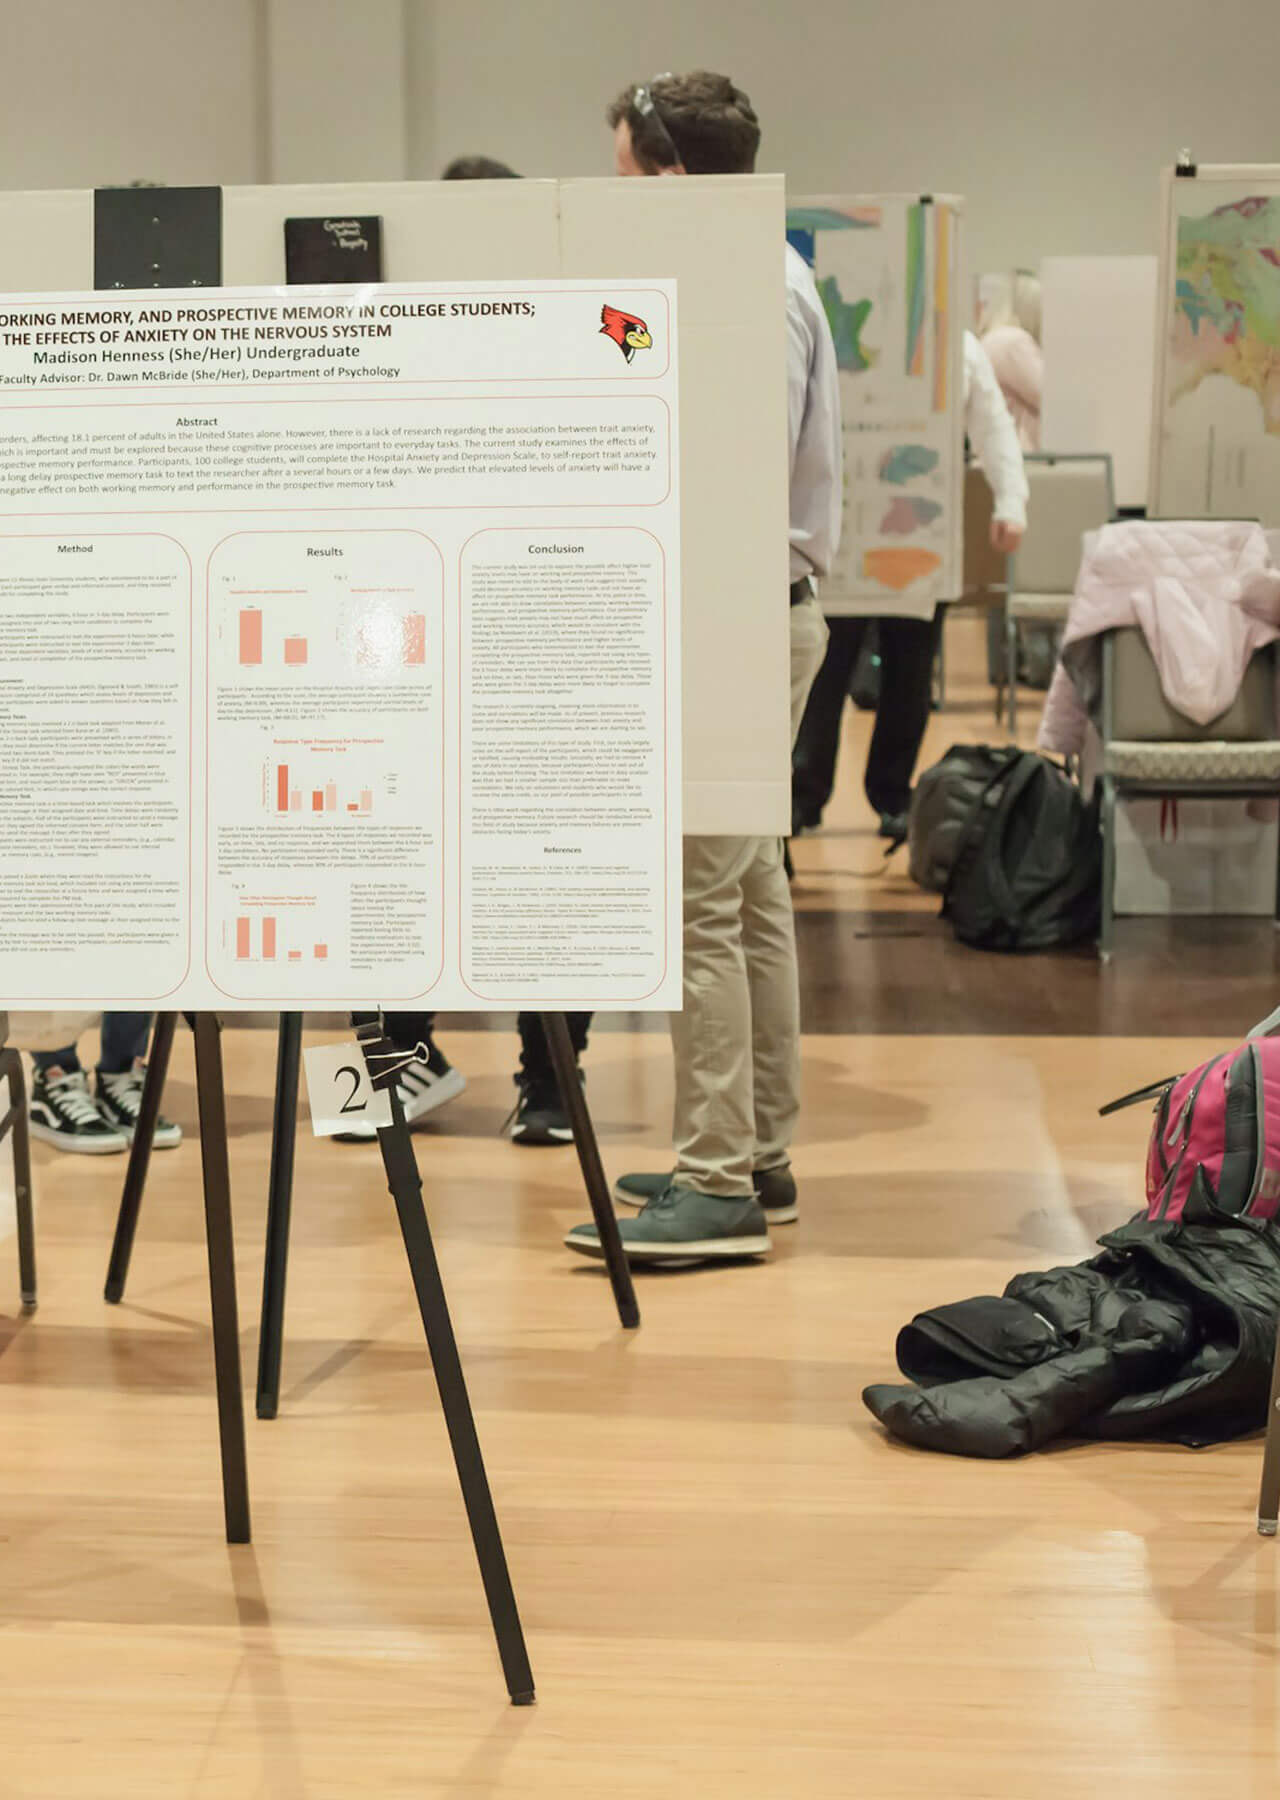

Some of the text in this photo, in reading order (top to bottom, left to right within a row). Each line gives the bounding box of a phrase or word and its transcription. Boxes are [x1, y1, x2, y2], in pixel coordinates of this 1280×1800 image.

[61, 310, 134, 327] MEMORY,
[139, 309, 172, 323] AND
[177, 307, 278, 322] PROSPECTIVE
[283, 305, 353, 320] MEMORY
[359, 305, 374, 318] IN
[380, 303, 446, 317] COLLEGE
[451, 301, 535, 318] STUDENTS;
[3, 323, 392, 346] THE EFFECTS OF ANXIETY ON THE NERVOUS SYSTEM
[33, 343, 360, 364] Madison Henness (She/Her) Undergraduate
[40, 371, 85, 383] Advisor:
[89, 371, 103, 382] Dr.
[107, 370, 138, 381] Dawn
[142, 368, 188, 381] McBride
[192, 367, 249, 382] (She/Her),
[253, 366, 320, 381] Department
[323, 365, 334, 377] of
[338, 364, 400, 379] Psychology
[176, 416, 218, 427] Abstract
[32, 432, 69, 445] affecting
[92, 432, 126, 444] percent
[139, 430, 166, 440] adults
[179, 429, 194, 440] the
[195, 429, 226, 439] United
[227, 429, 254, 439] States
[329, 427, 354, 437] there
[373, 426, 390, 436] lack
[403, 425, 442, 436] research
[444, 424, 487, 437] regarding
[489, 424, 504, 434] the
[506, 424, 556, 434] association
[558, 423, 597, 433] between
[599, 423, 618, 432] trait
[26, 446, 68, 458] important
[71, 445, 88, 455] and
[90, 446, 111, 454] must
[127, 443, 166, 456] explored
[167, 443, 203, 453] because
[206, 442, 230, 452] these
[232, 443, 272, 454] cognitive
[274, 443, 317, 453] processes
[336, 441, 380, 452] important
[394, 438, 435, 451] everyday
[464, 438, 481, 448] The
[483, 438, 516, 447] current
[518, 437, 543, 449] study
[545, 438, 587, 447] examines
[589, 436, 604, 446] the
[607, 436, 636, 446] effects
[39, 460, 75, 470] memory
[213, 454, 244, 467] college
[289, 453, 304, 463] will
[307, 452, 348, 465] complete
[351, 452, 366, 462] the
[368, 452, 404, 464] Hospital
[406, 452, 440, 464] Anxiety
[442, 451, 459, 461] and
[461, 450, 511, 463] Depression
[603, 449, 621, 458] trait
[0, 485, 36, 497] negative
[38, 484, 62, 494] effect
[79, 483, 99, 493] both
[101, 482, 137, 495] working
[139, 484, 176, 494] memory
[178, 481, 194, 491] and
[197, 480, 253, 493] performance
[266, 480, 281, 489] the
[283, 480, 334, 491] prospective
[337, 480, 374, 490] memory
[57, 542, 93, 553] Method
[307, 545, 343, 556] Results
[528, 542, 584, 553] Conclusion
[334, 1066, 367, 1113] 2
